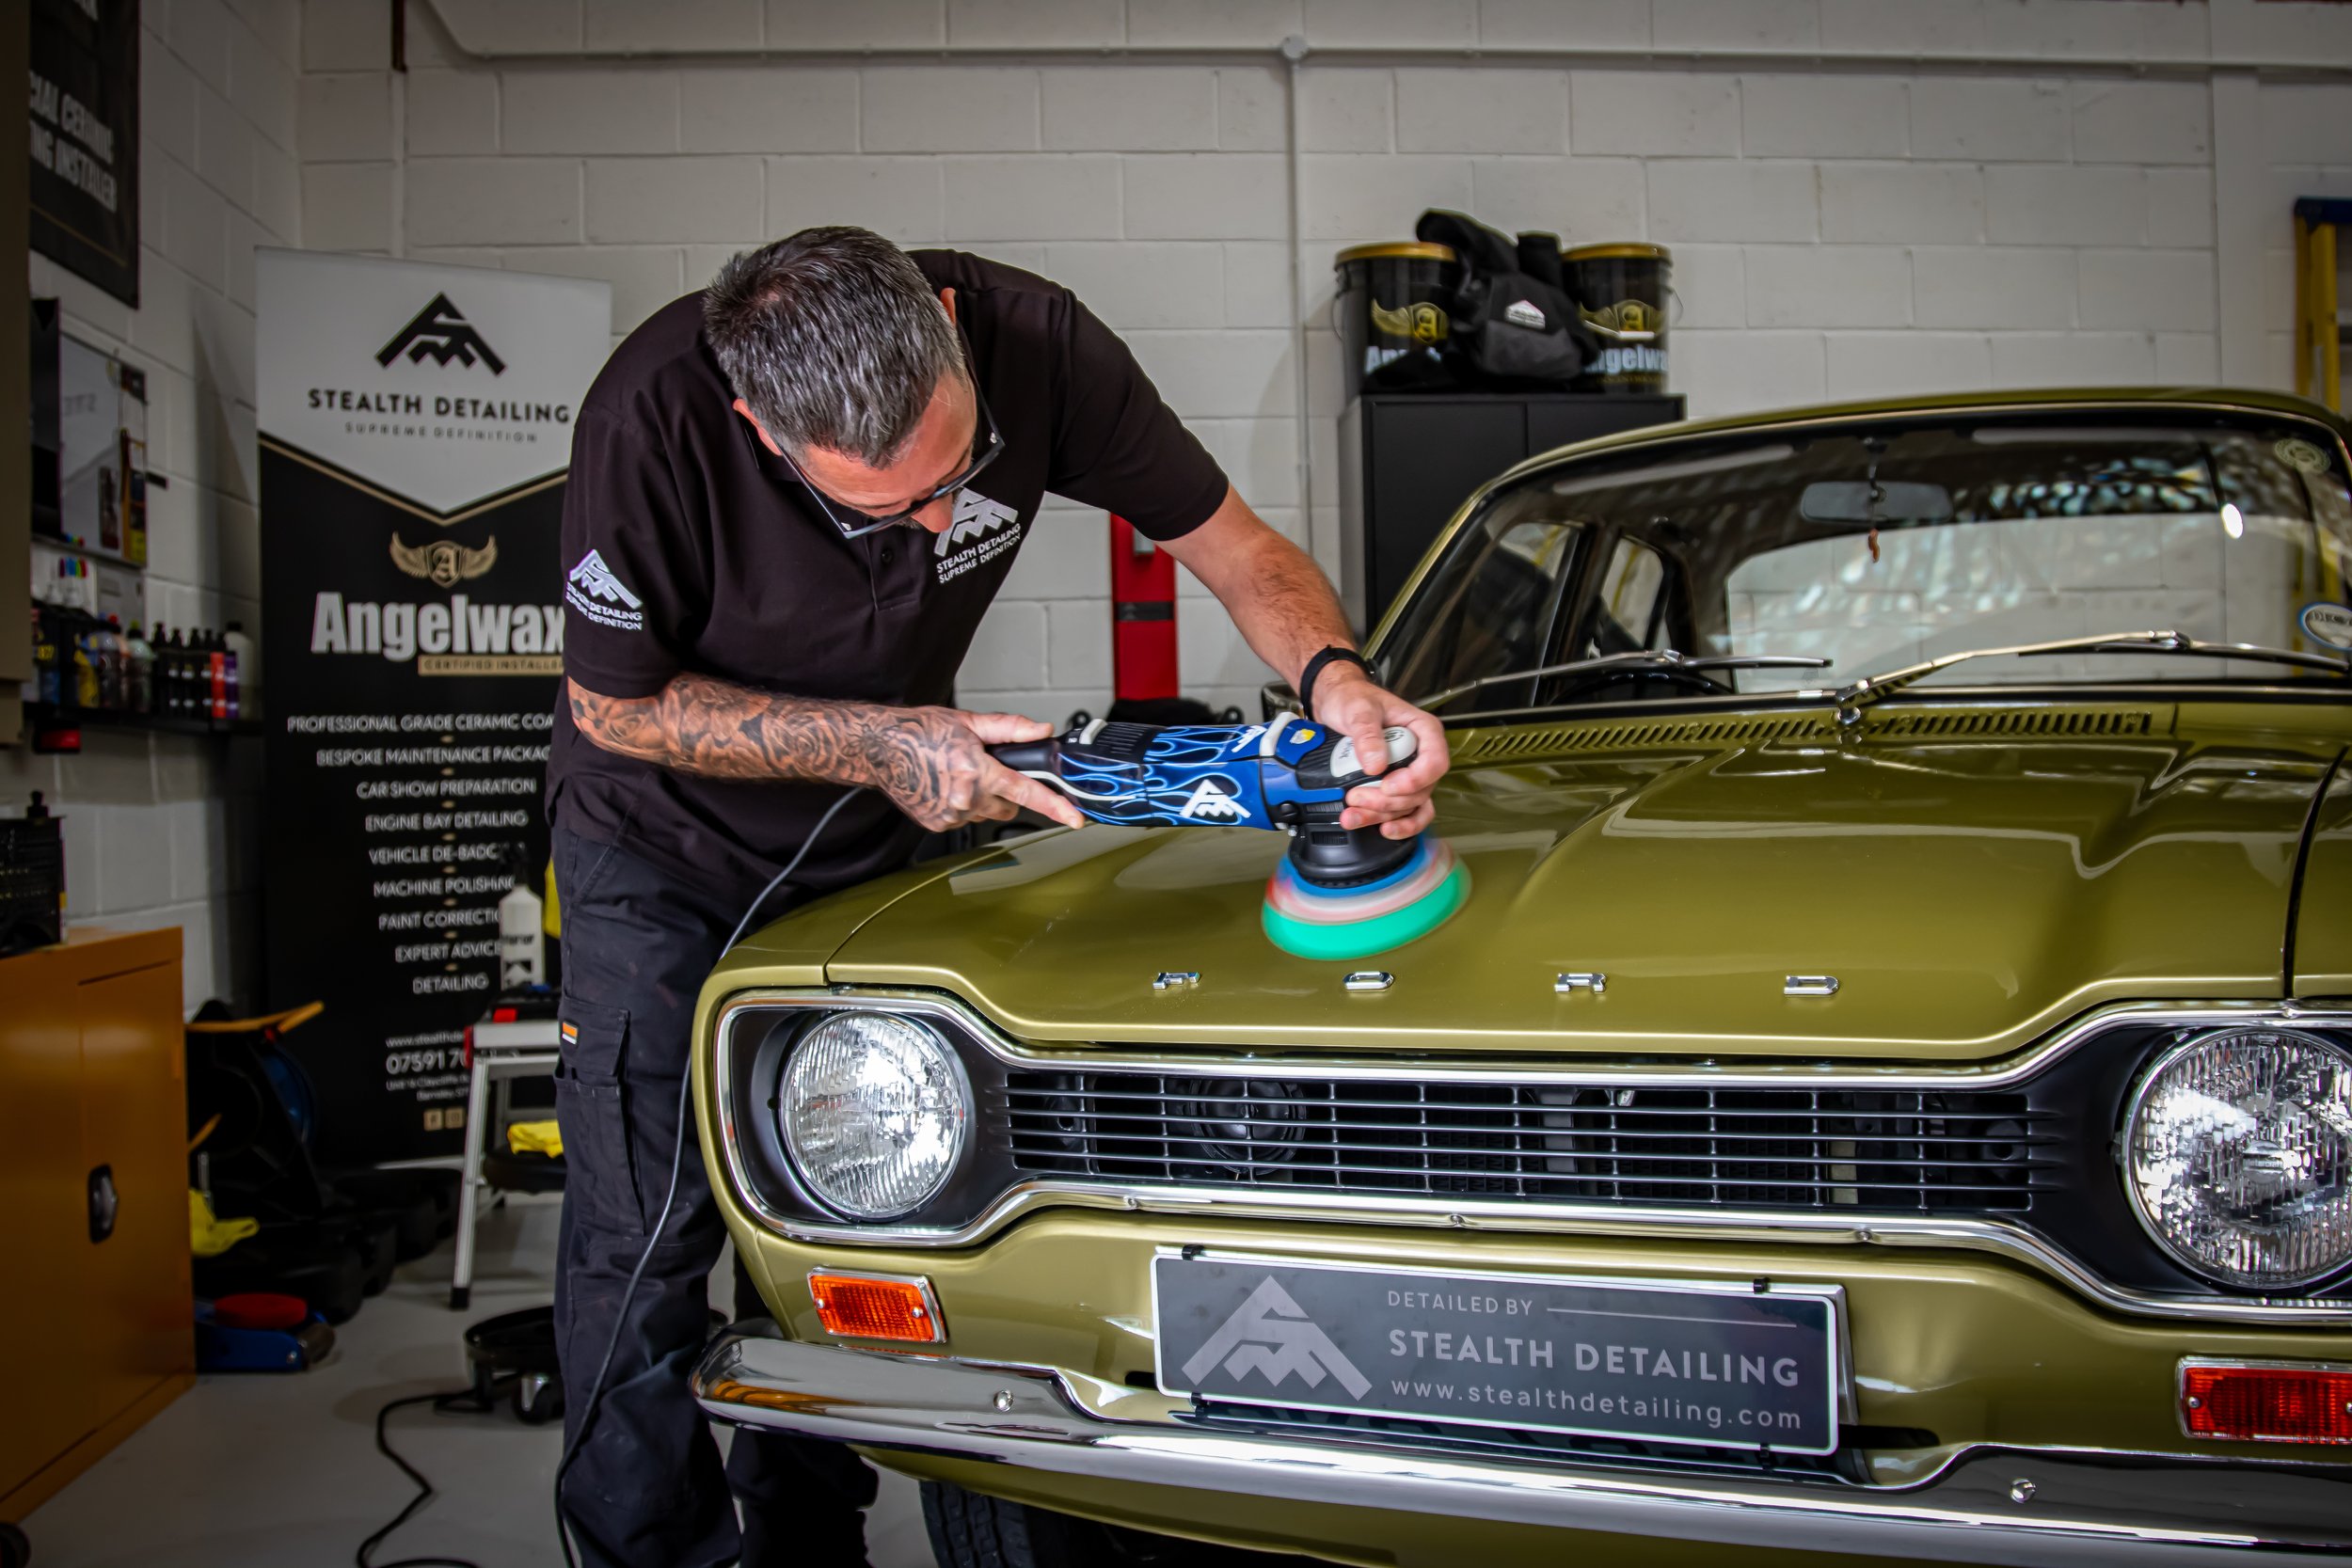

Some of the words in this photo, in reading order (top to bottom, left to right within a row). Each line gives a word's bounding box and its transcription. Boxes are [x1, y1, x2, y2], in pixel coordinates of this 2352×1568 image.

[308, 388, 422, 415] STEALTH
[434, 396, 570, 424] DETAILING
[344, 422, 426, 438] SUPREME
[433, 426, 537, 444] DEFINITION
[936, 547, 977, 574] STEALTH
[977, 523, 1021, 554] DETAILING
[939, 558, 977, 584] SUPREME
[979, 532, 1021, 564] DEFINITION
[588, 611, 643, 632] DEFINITION
[589, 601, 643, 621] DETAILING
[310, 592, 564, 662] Angelwax
[424, 659, 491, 672] CERTIFIED
[287, 715, 398, 734] PROFESSIONAL
[400, 714, 453, 732] GRADE
[455, 713, 519, 731] CERAMIC
[316, 748, 384, 767] BESPOKE
[386, 746, 490, 765] MAINTENANCE
[357, 781, 389, 800] CAR
[390, 780, 437, 798] SHOW
[439, 778, 536, 796] PREPARATION
[365, 814, 421, 832] ENGINE
[423, 813, 453, 831] BAY
[454, 809, 529, 828] DETAILING
[369, 847, 430, 864] VEHICLE
[373, 879, 443, 897] MACHINE
[379, 911, 421, 930] PAINT
[395, 943, 448, 962] EXPERT
[412, 973, 489, 993] DETAILING
[1152, 970, 1841, 998] FORD
[386, 1050, 445, 1075] 07591
[1388, 1290, 1499, 1315] DETAILED
[1505, 1299, 1534, 1316] BY
[1389, 1329, 1555, 1369] STEALTH
[1575, 1343, 1799, 1387] DETAILING
[1391, 1379, 1802, 1430] www.stealthdetailing.com
